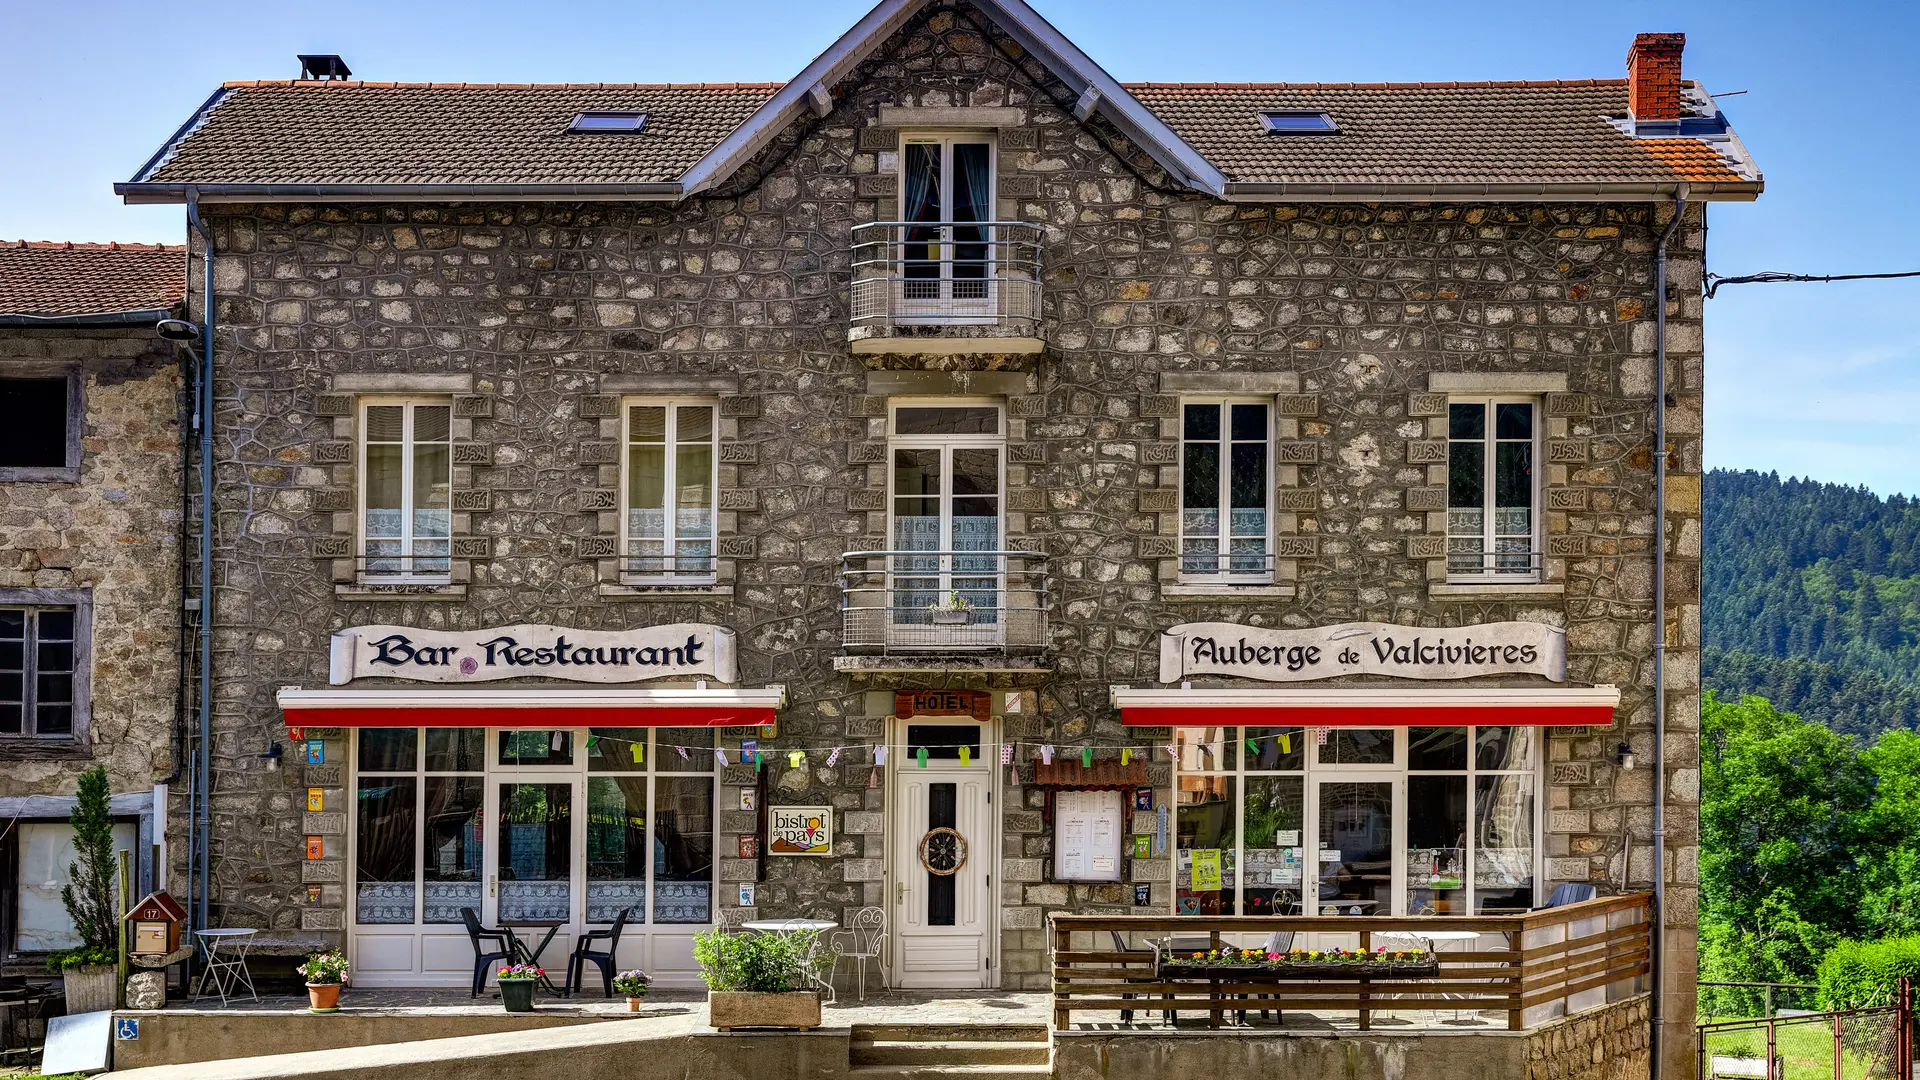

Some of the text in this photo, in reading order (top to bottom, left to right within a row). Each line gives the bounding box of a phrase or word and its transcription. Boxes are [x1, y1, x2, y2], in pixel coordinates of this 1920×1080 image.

[367, 634, 705, 667] Bar Restaurant
[1190, 636, 1538, 672] Auberge de Valcivieres
[914, 692, 969, 710] HOTEL
[774, 811, 827, 829] bistrot
[773, 828, 825, 847] de pays
[146, 910, 157, 918] 17
